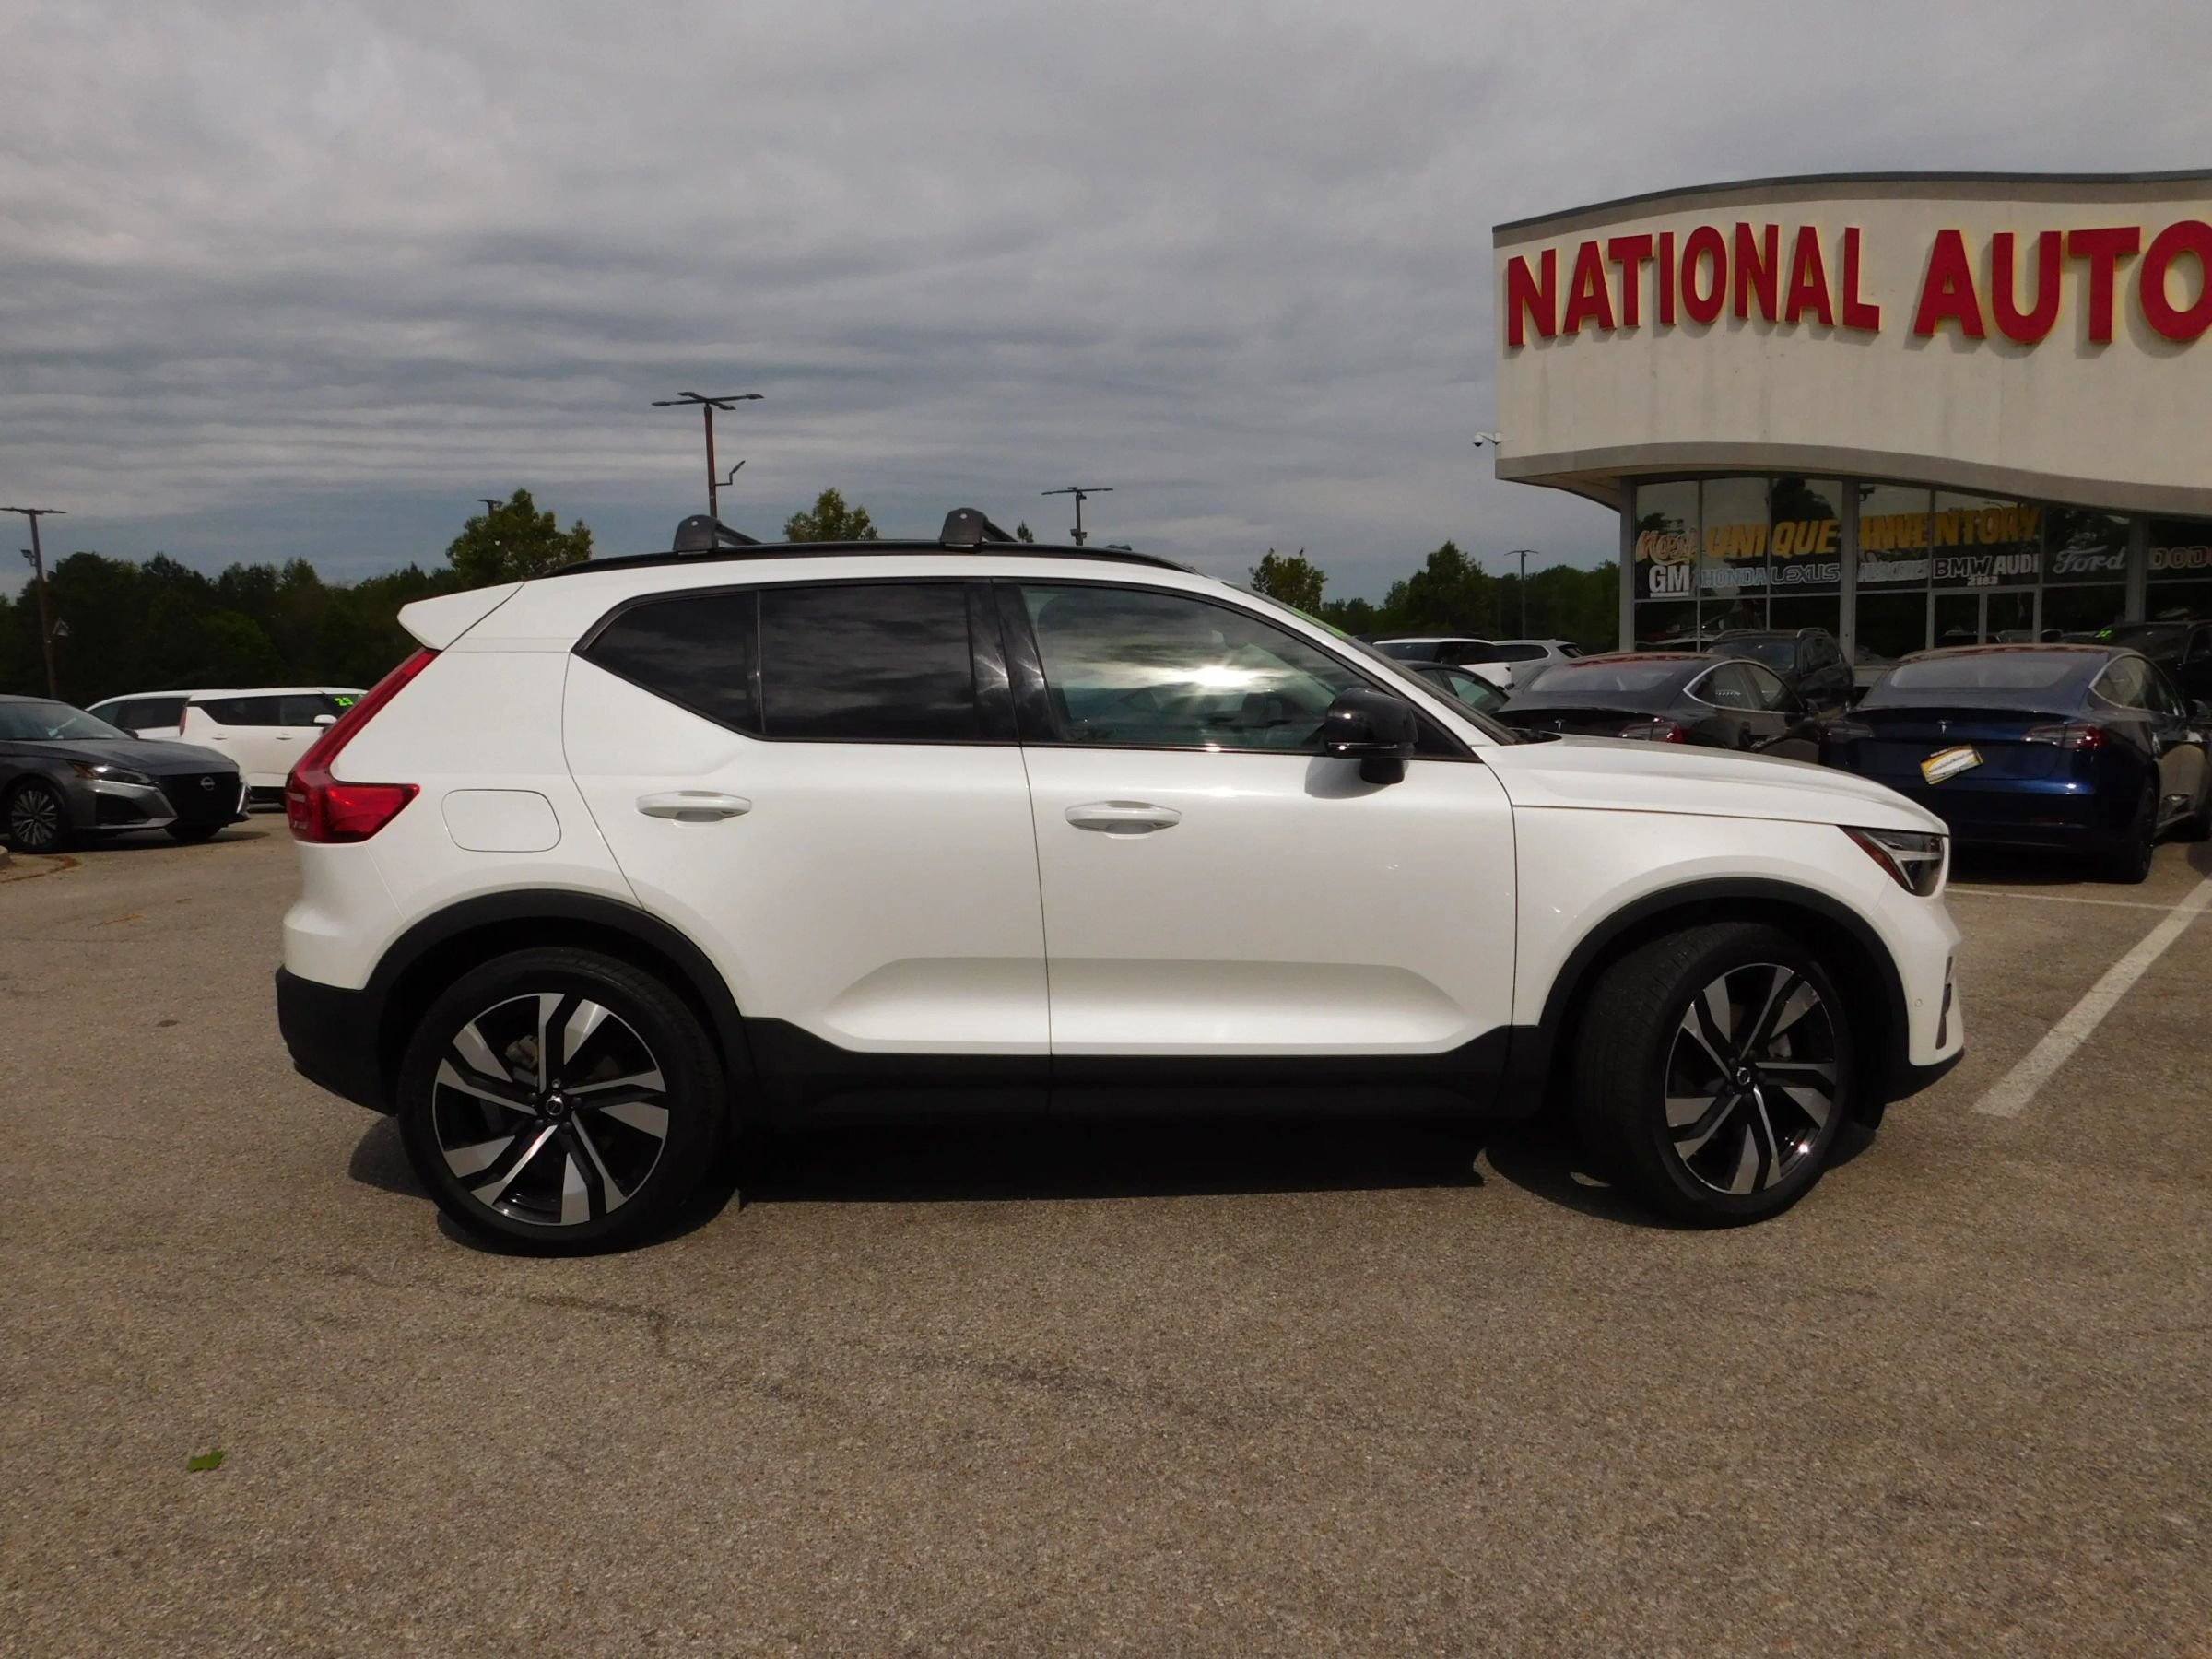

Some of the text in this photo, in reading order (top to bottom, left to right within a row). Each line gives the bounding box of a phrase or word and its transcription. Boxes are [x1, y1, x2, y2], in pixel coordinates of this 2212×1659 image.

[1507, 220, 2212, 347] NATIONAL AUTO
[1706, 520, 1839, 558] UNIQUE
[1860, 506, 2038, 550] INVENTORY
[1649, 565, 1690, 593] GM
[1700, 568, 1767, 588] HONDA
[1771, 563, 1841, 584] LEXUS
[1933, 557, 1992, 579] BMW
[1994, 553, 2039, 575] AUDI
[2053, 546, 2126, 574] Ford
[2148, 545, 2212, 570] DOD
